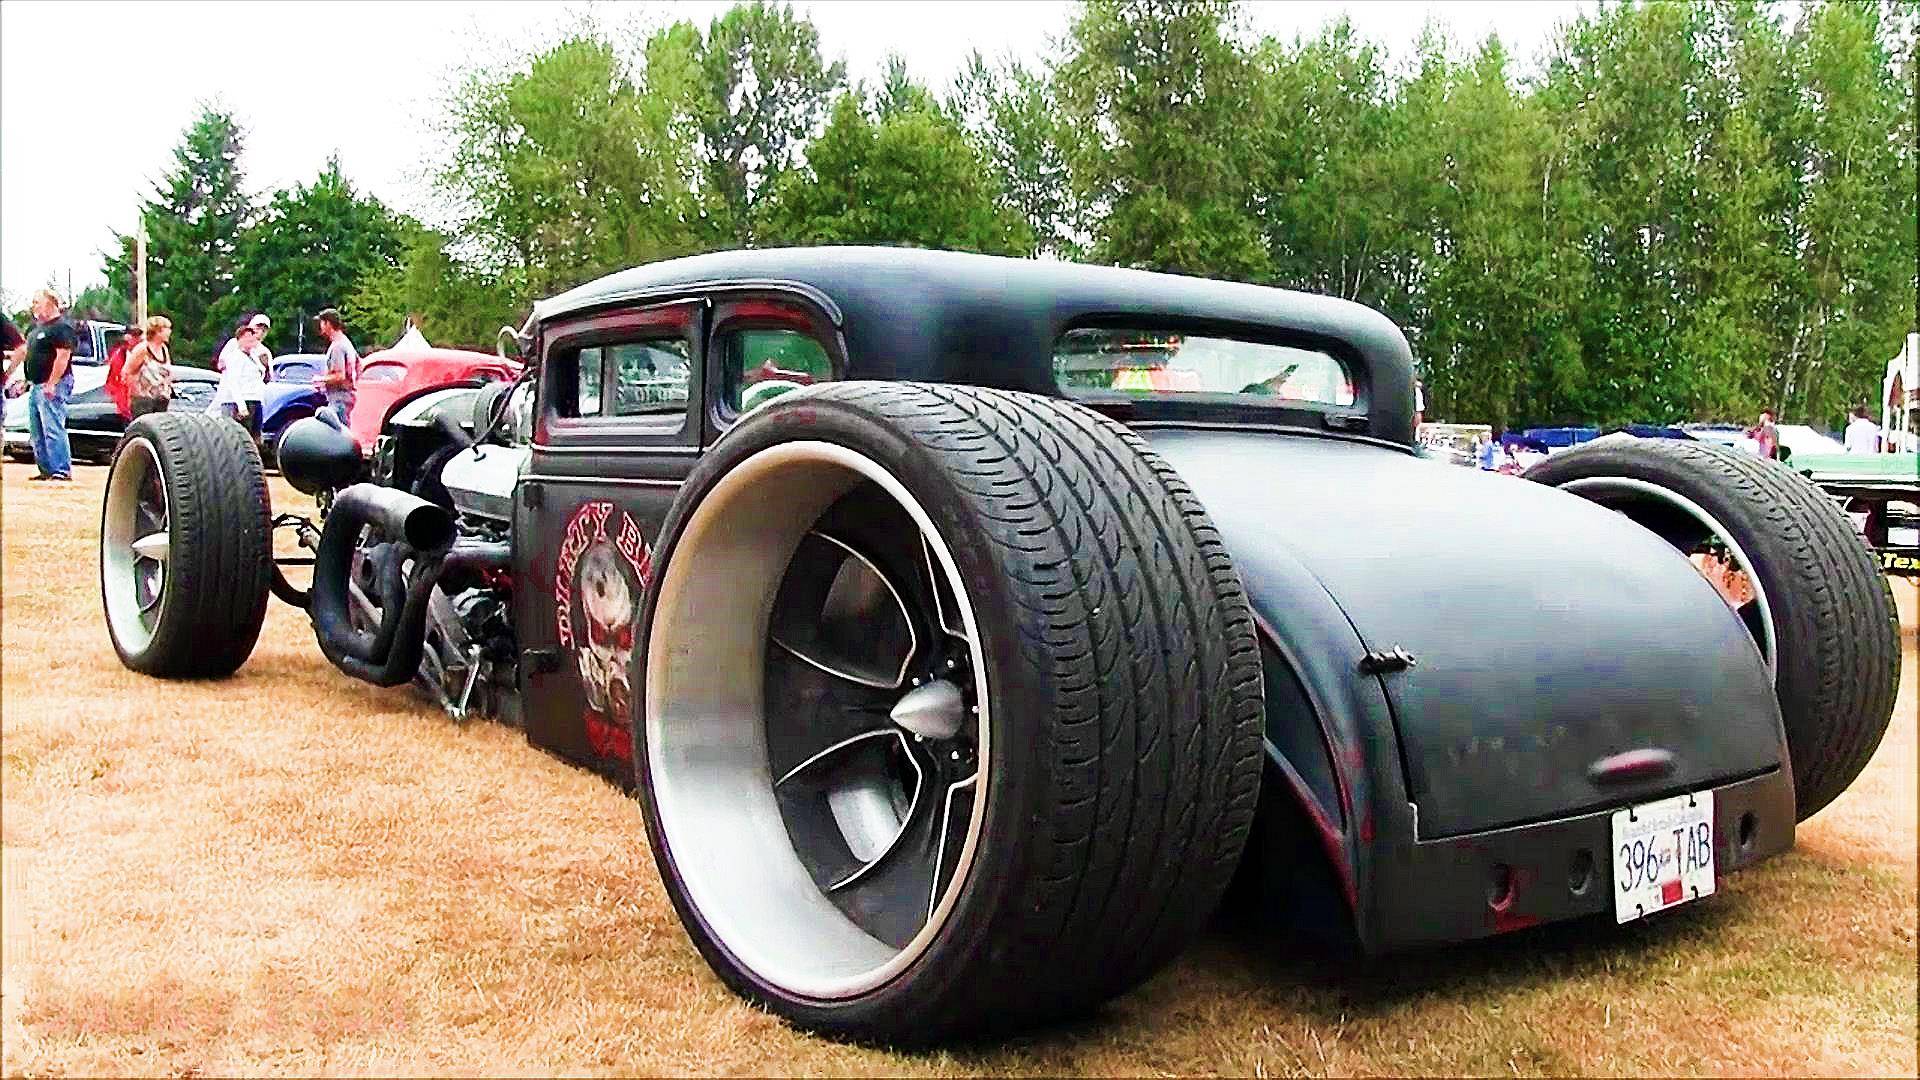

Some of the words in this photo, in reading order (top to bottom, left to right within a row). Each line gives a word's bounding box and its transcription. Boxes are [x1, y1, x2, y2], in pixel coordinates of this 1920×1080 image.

[555, 502, 614, 649] DIRTY
[1620, 835, 1659, 892] 396
[1673, 822, 1711, 875] TAB
